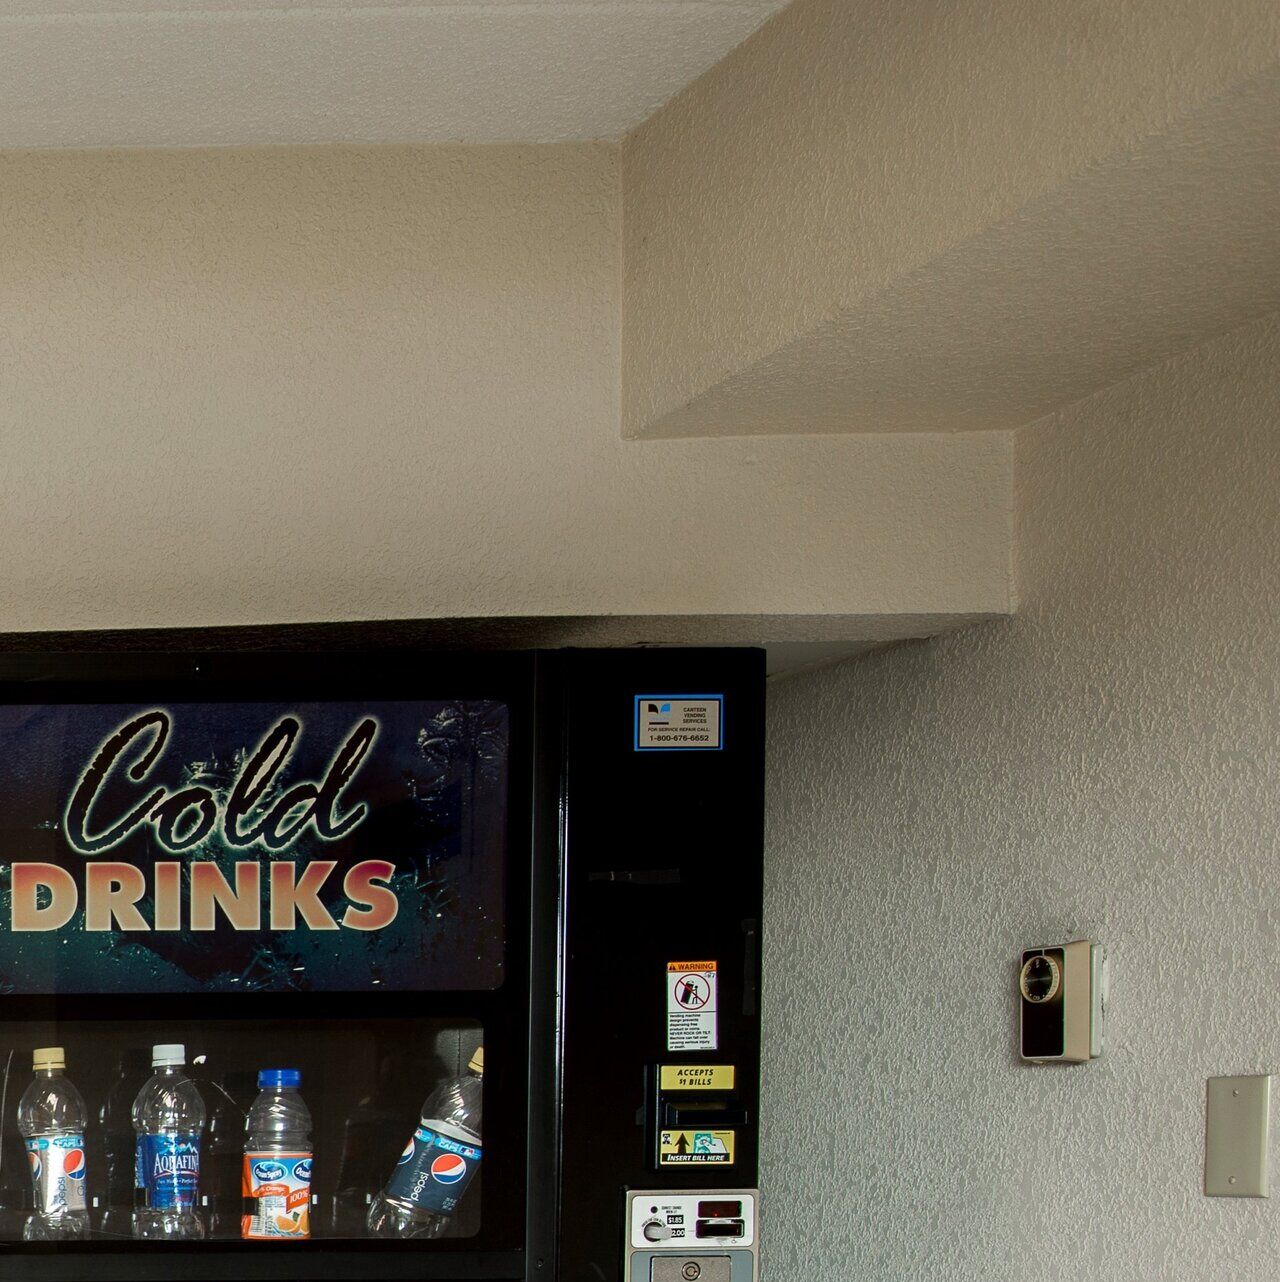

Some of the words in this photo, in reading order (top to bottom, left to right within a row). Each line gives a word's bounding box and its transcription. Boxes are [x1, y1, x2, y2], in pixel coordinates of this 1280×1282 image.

[64, 709, 379, 854] Cold
[11, 860, 400, 931] DRINKS
[679, 1078, 686, 1086] $1
[689, 1078, 712, 1086] BILLS
[410, 1171, 430, 1201] pepsi
